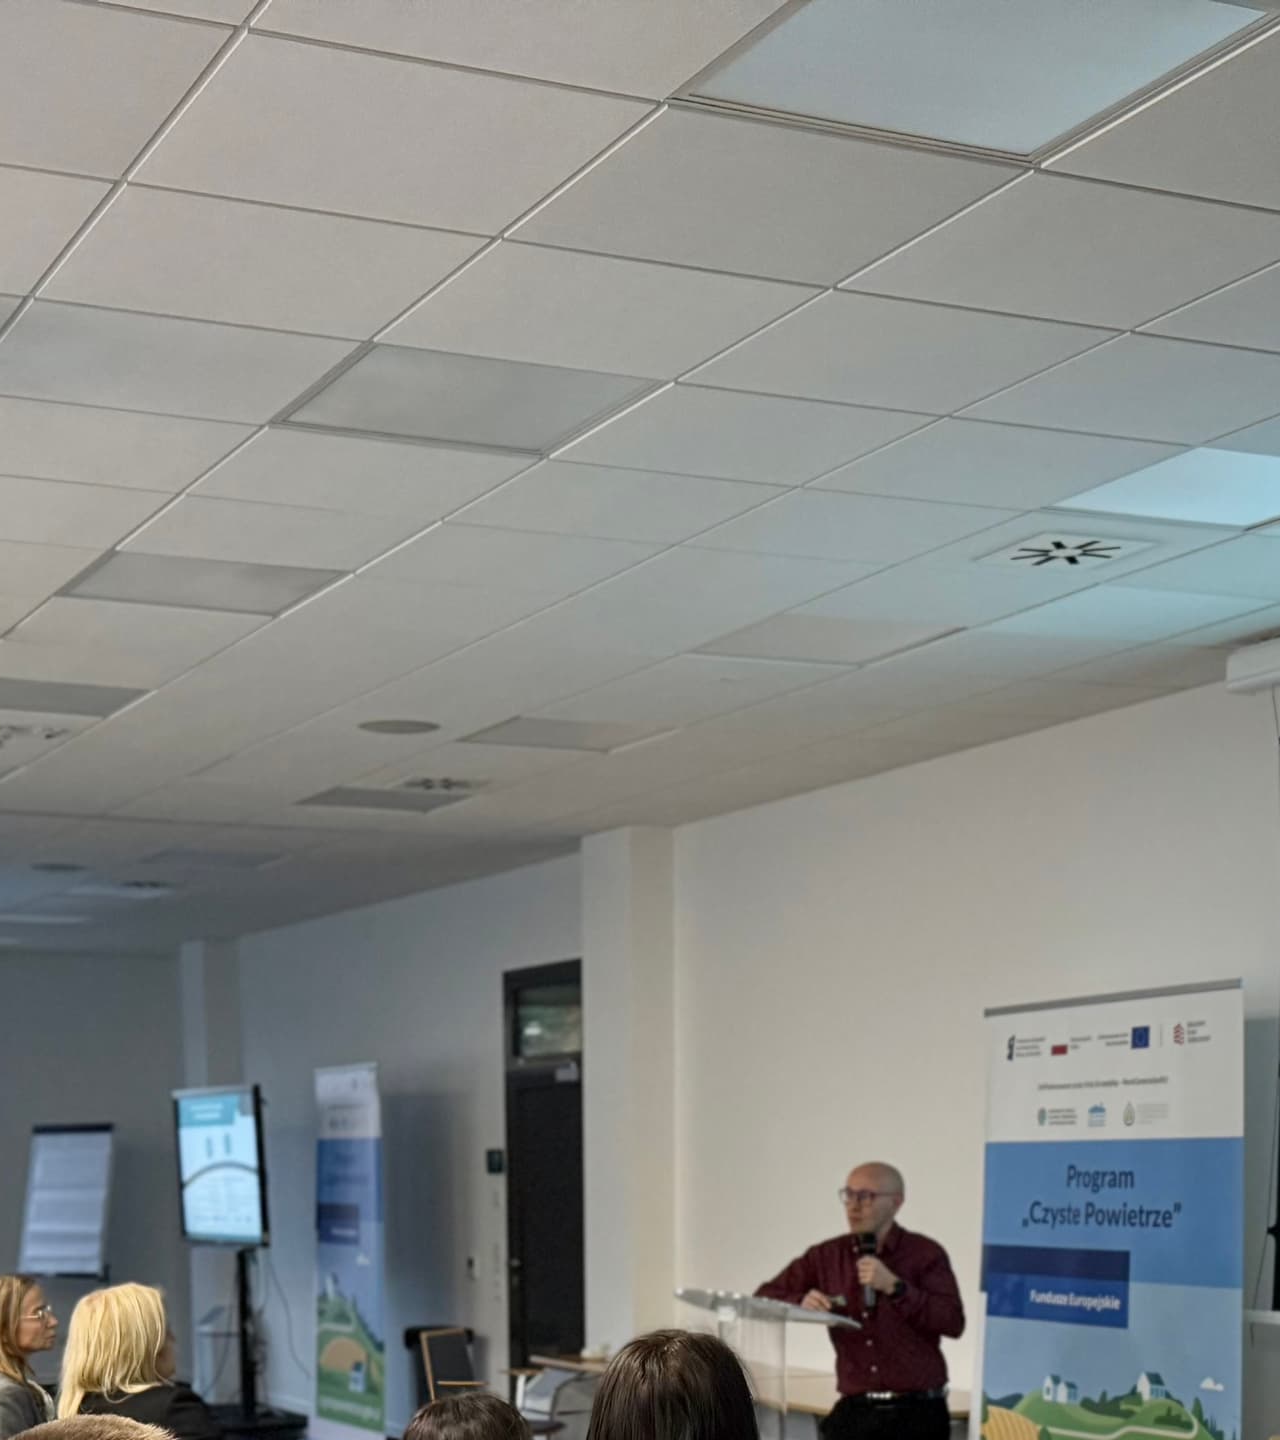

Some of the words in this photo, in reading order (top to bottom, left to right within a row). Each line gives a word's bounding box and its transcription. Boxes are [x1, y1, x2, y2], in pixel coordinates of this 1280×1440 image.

[1066, 1164, 1135, 1194] Program
[1022, 1200, 1081, 1230] „Czyste
[1085, 1201, 1182, 1228] Powietrze”
[1030, 1289, 1068, 1306] Fundusze
